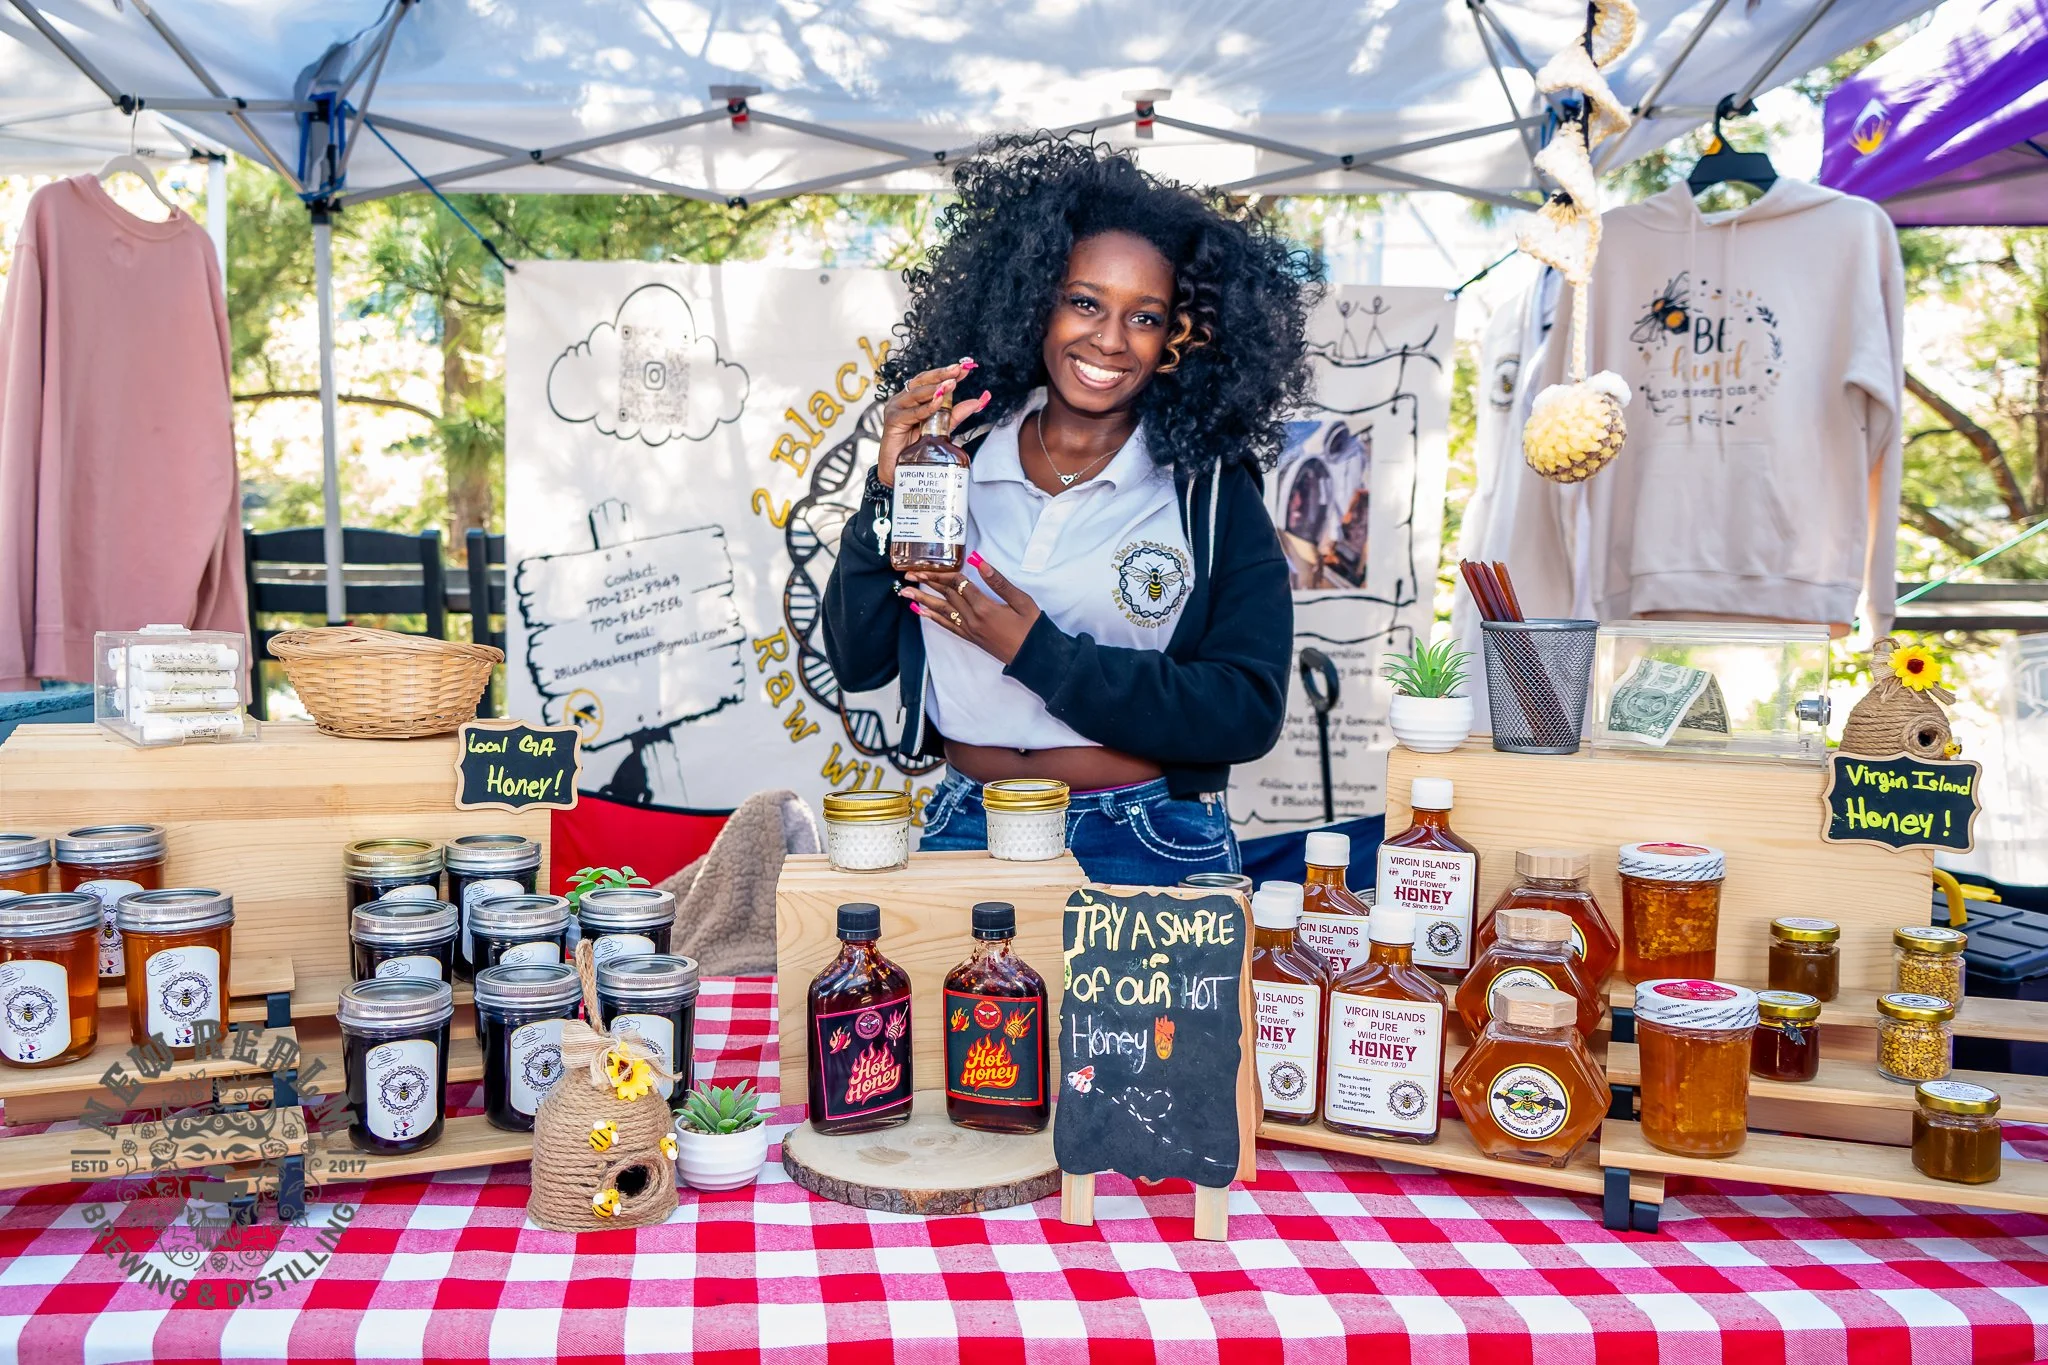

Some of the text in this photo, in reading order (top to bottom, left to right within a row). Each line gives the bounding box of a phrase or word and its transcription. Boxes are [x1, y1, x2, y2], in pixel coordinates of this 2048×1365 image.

[1694, 317, 1733, 354] BE
[1661, 389, 1678, 399] to
[751, 336, 891, 529] 2 Black
[1114, 542, 1140, 561] Black
[1141, 540, 1191, 577] Beekeepers
[754, 627, 821, 743] Raw
[468, 732, 508, 753] Local
[1846, 764, 1972, 796] Virgin Island
[1390, 856, 1461, 871] VIRGIN ISLANDS
[1400, 878, 1447, 889] Wild Flower
[1412, 870, 1436, 880] PURE
[1394, 885, 1453, 905] HONEY
[1065, 903, 1235, 953] TRY A SAMPLE
[1300, 923, 1359, 935] GIN ISLANDS
[1308, 935, 1333, 945] PURE
[1115, 971, 1172, 1009] OUR
[1181, 974, 1234, 1011] HOT
[1262, 993, 1304, 1005] ISLANDS
[1258, 1005, 1278, 1014] URE
[1345, 1006, 1426, 1023] VIRGIN ISLANDS
[1260, 1016, 1290, 1026] Flower
[1370, 1021, 1398, 1033] PURE
[1072, 1013, 1148, 1074] Honey
[1260, 1025, 1297, 1043] NEY
[1357, 1031, 1410, 1043] Wild Flower
[1271, 1043, 1287, 1051] 1970
[1349, 1039, 1417, 1062] HONEY
[965, 1046, 1011, 1069] Hot
[1370, 1059, 1389, 1067] Since
[1391, 1061, 1407, 1069] 1970
[851, 1055, 892, 1084] Hot
[962, 1065, 1018, 1085] Honey
[845, 1064, 901, 1102] Honey
[1540, 1114, 1561, 1135] Jamaica
